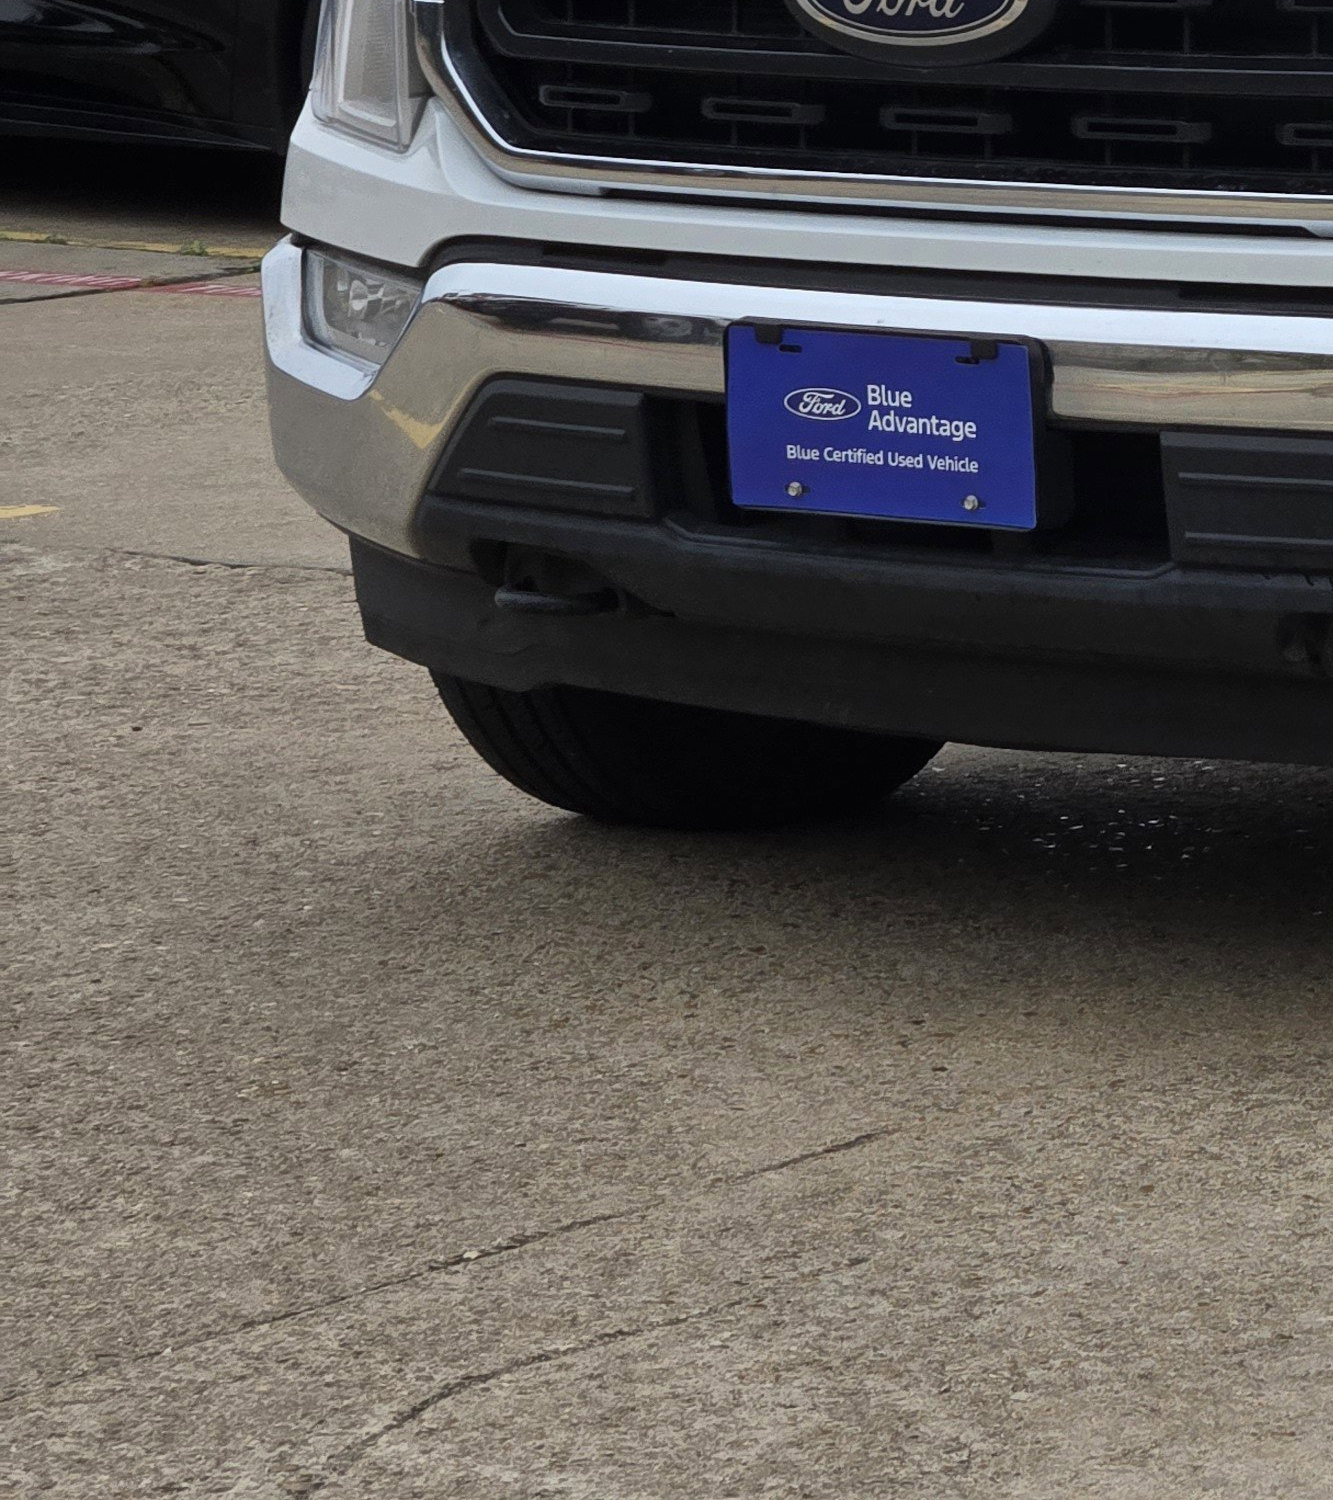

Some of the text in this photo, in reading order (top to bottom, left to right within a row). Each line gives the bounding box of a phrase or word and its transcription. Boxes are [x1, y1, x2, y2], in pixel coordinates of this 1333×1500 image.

[799, 391, 846, 416] Ford
[867, 384, 912, 407] Blue
[868, 410, 977, 441] Advantage
[786, 445, 979, 473] Blue Certified Used Vehicle
